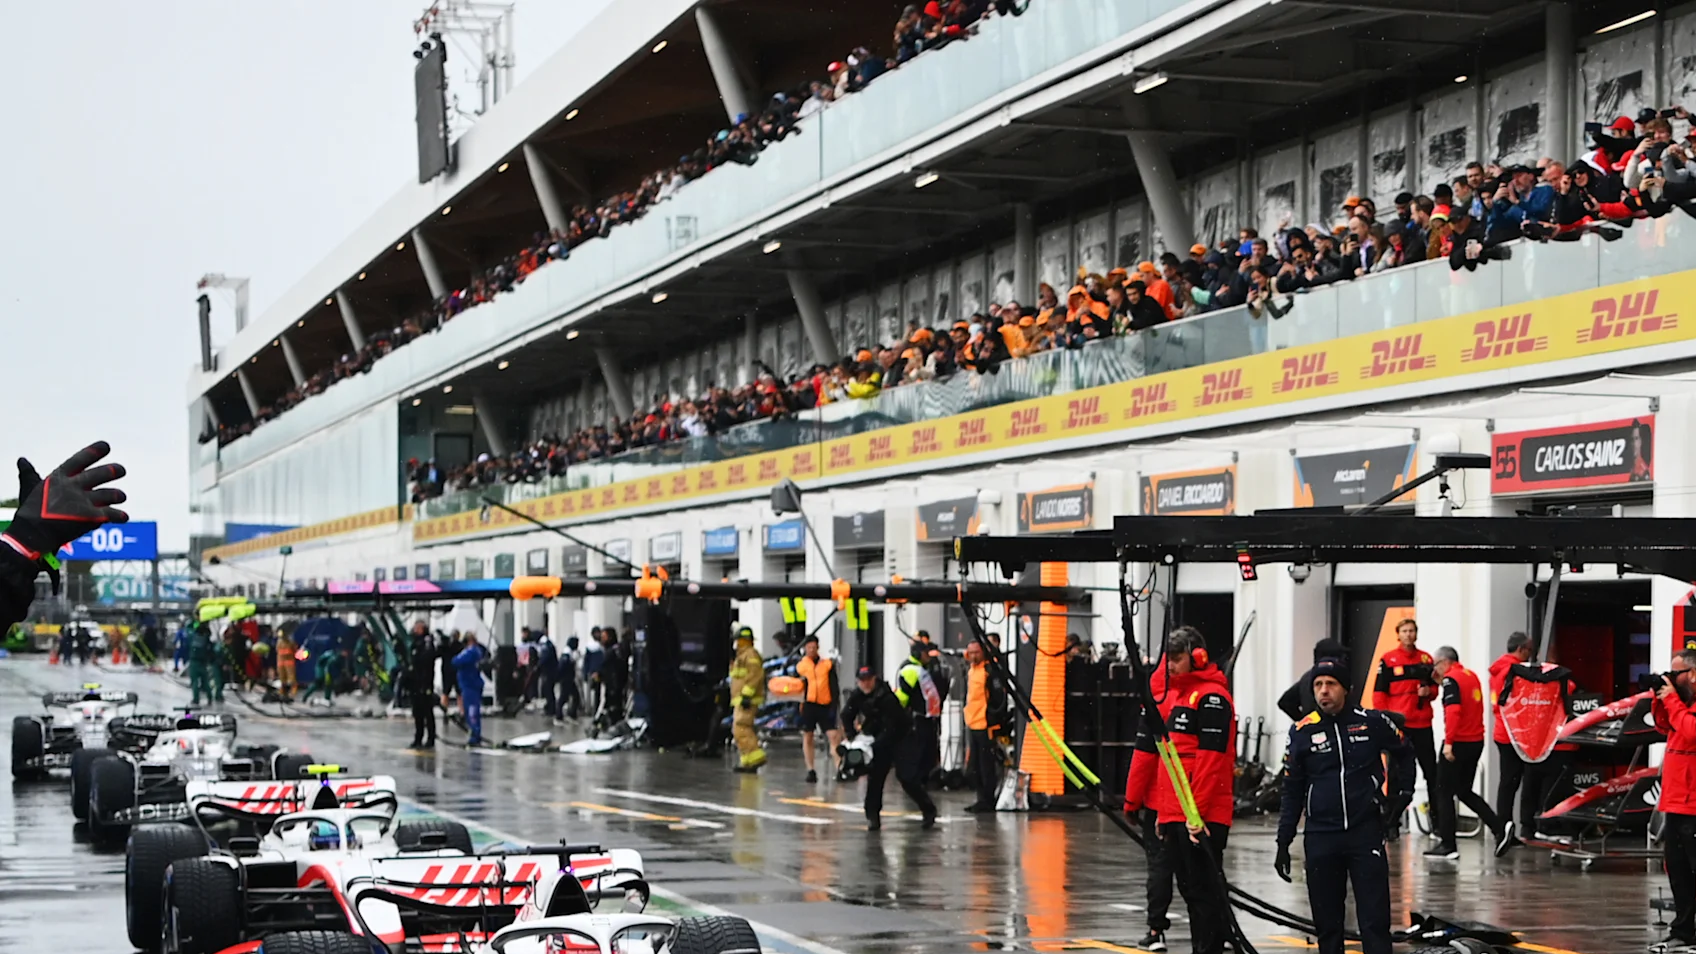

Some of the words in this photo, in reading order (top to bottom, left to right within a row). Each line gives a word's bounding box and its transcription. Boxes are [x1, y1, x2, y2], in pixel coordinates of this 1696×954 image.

[1591, 289, 1664, 341] DHL
[1470, 313, 1537, 360] DHL
[1281, 352, 1329, 392] DHL
[1370, 334, 1425, 377] DHL
[1131, 383, 1168, 417] DHL
[1201, 369, 1244, 405] DHL
[1010, 407, 1040, 437] DHL
[1068, 396, 1101, 428] DHL
[1495, 445, 1517, 480] 55
[1534, 442, 1584, 474] CARLOS
[1584, 437, 1626, 470] SAINZ
[1056, 497, 1082, 517] NORRIS
[1158, 486, 1184, 508] DANIEL
[1184, 482, 1225, 505] RICCIARDO
[1572, 699, 1600, 711] aws
[1573, 773, 1600, 785] aws
